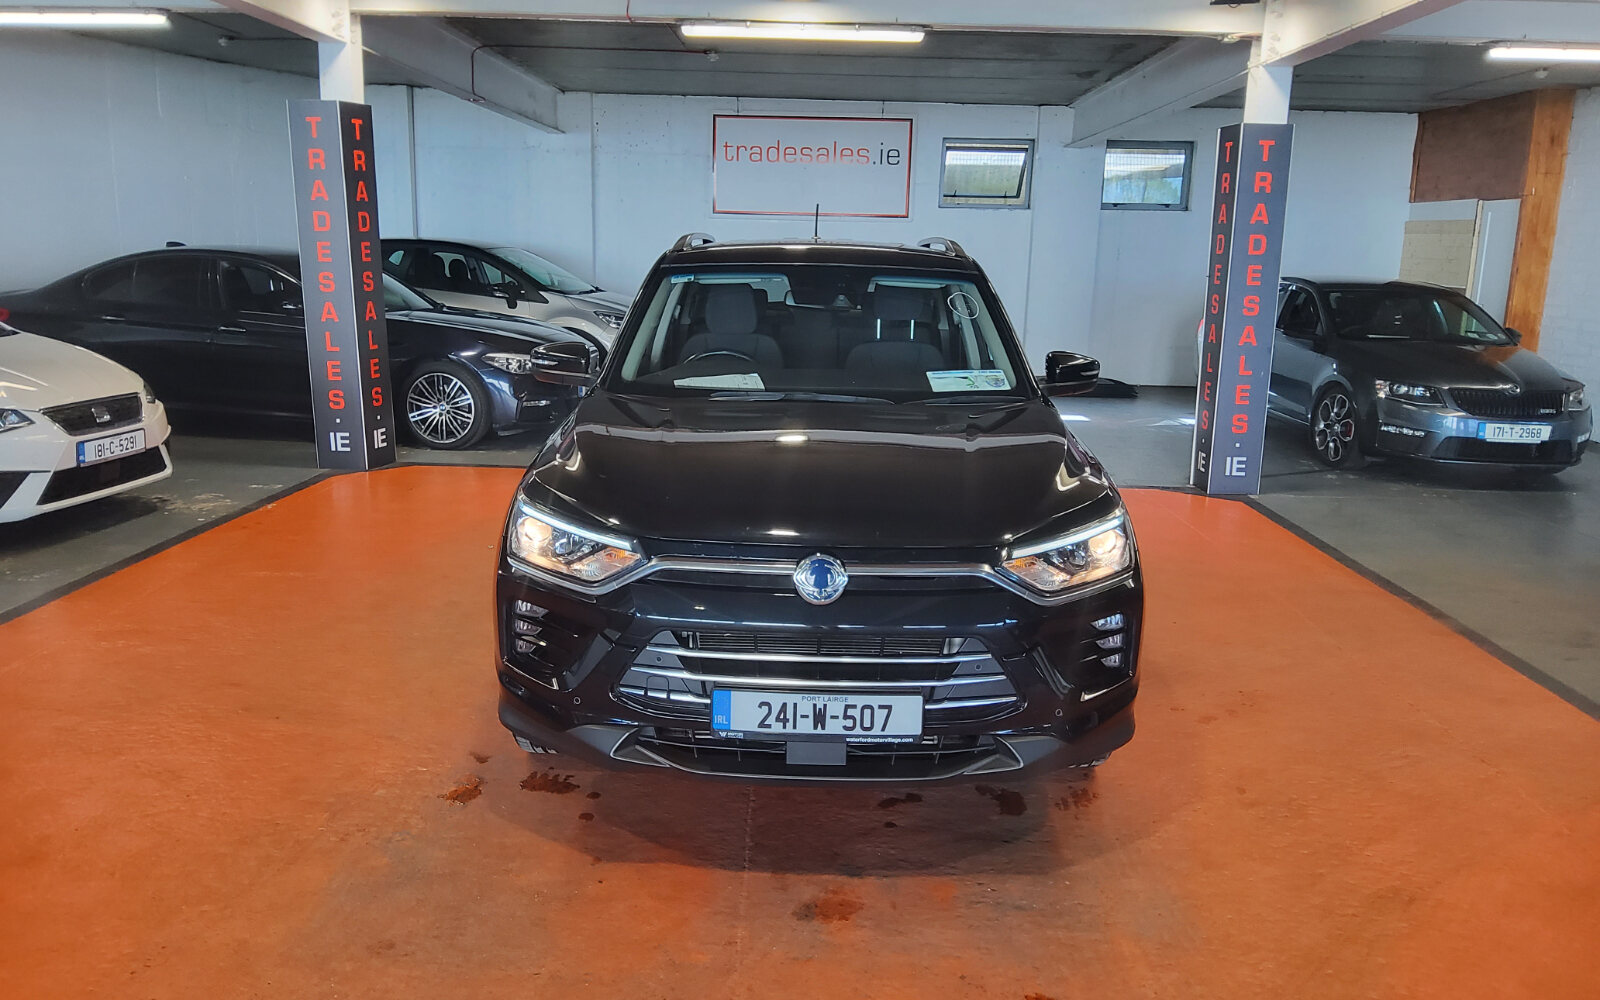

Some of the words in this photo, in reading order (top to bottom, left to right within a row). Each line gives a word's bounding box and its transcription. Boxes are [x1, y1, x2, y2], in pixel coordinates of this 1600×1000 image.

[723, 139, 900, 166] tradesales.ie
[1492, 426, 1542, 439] 171-T-2968
[94, 435, 137, 459] 181-C-5291
[714, 715, 729, 725] IRL
[757, 701, 893, 732] 241-W-507
